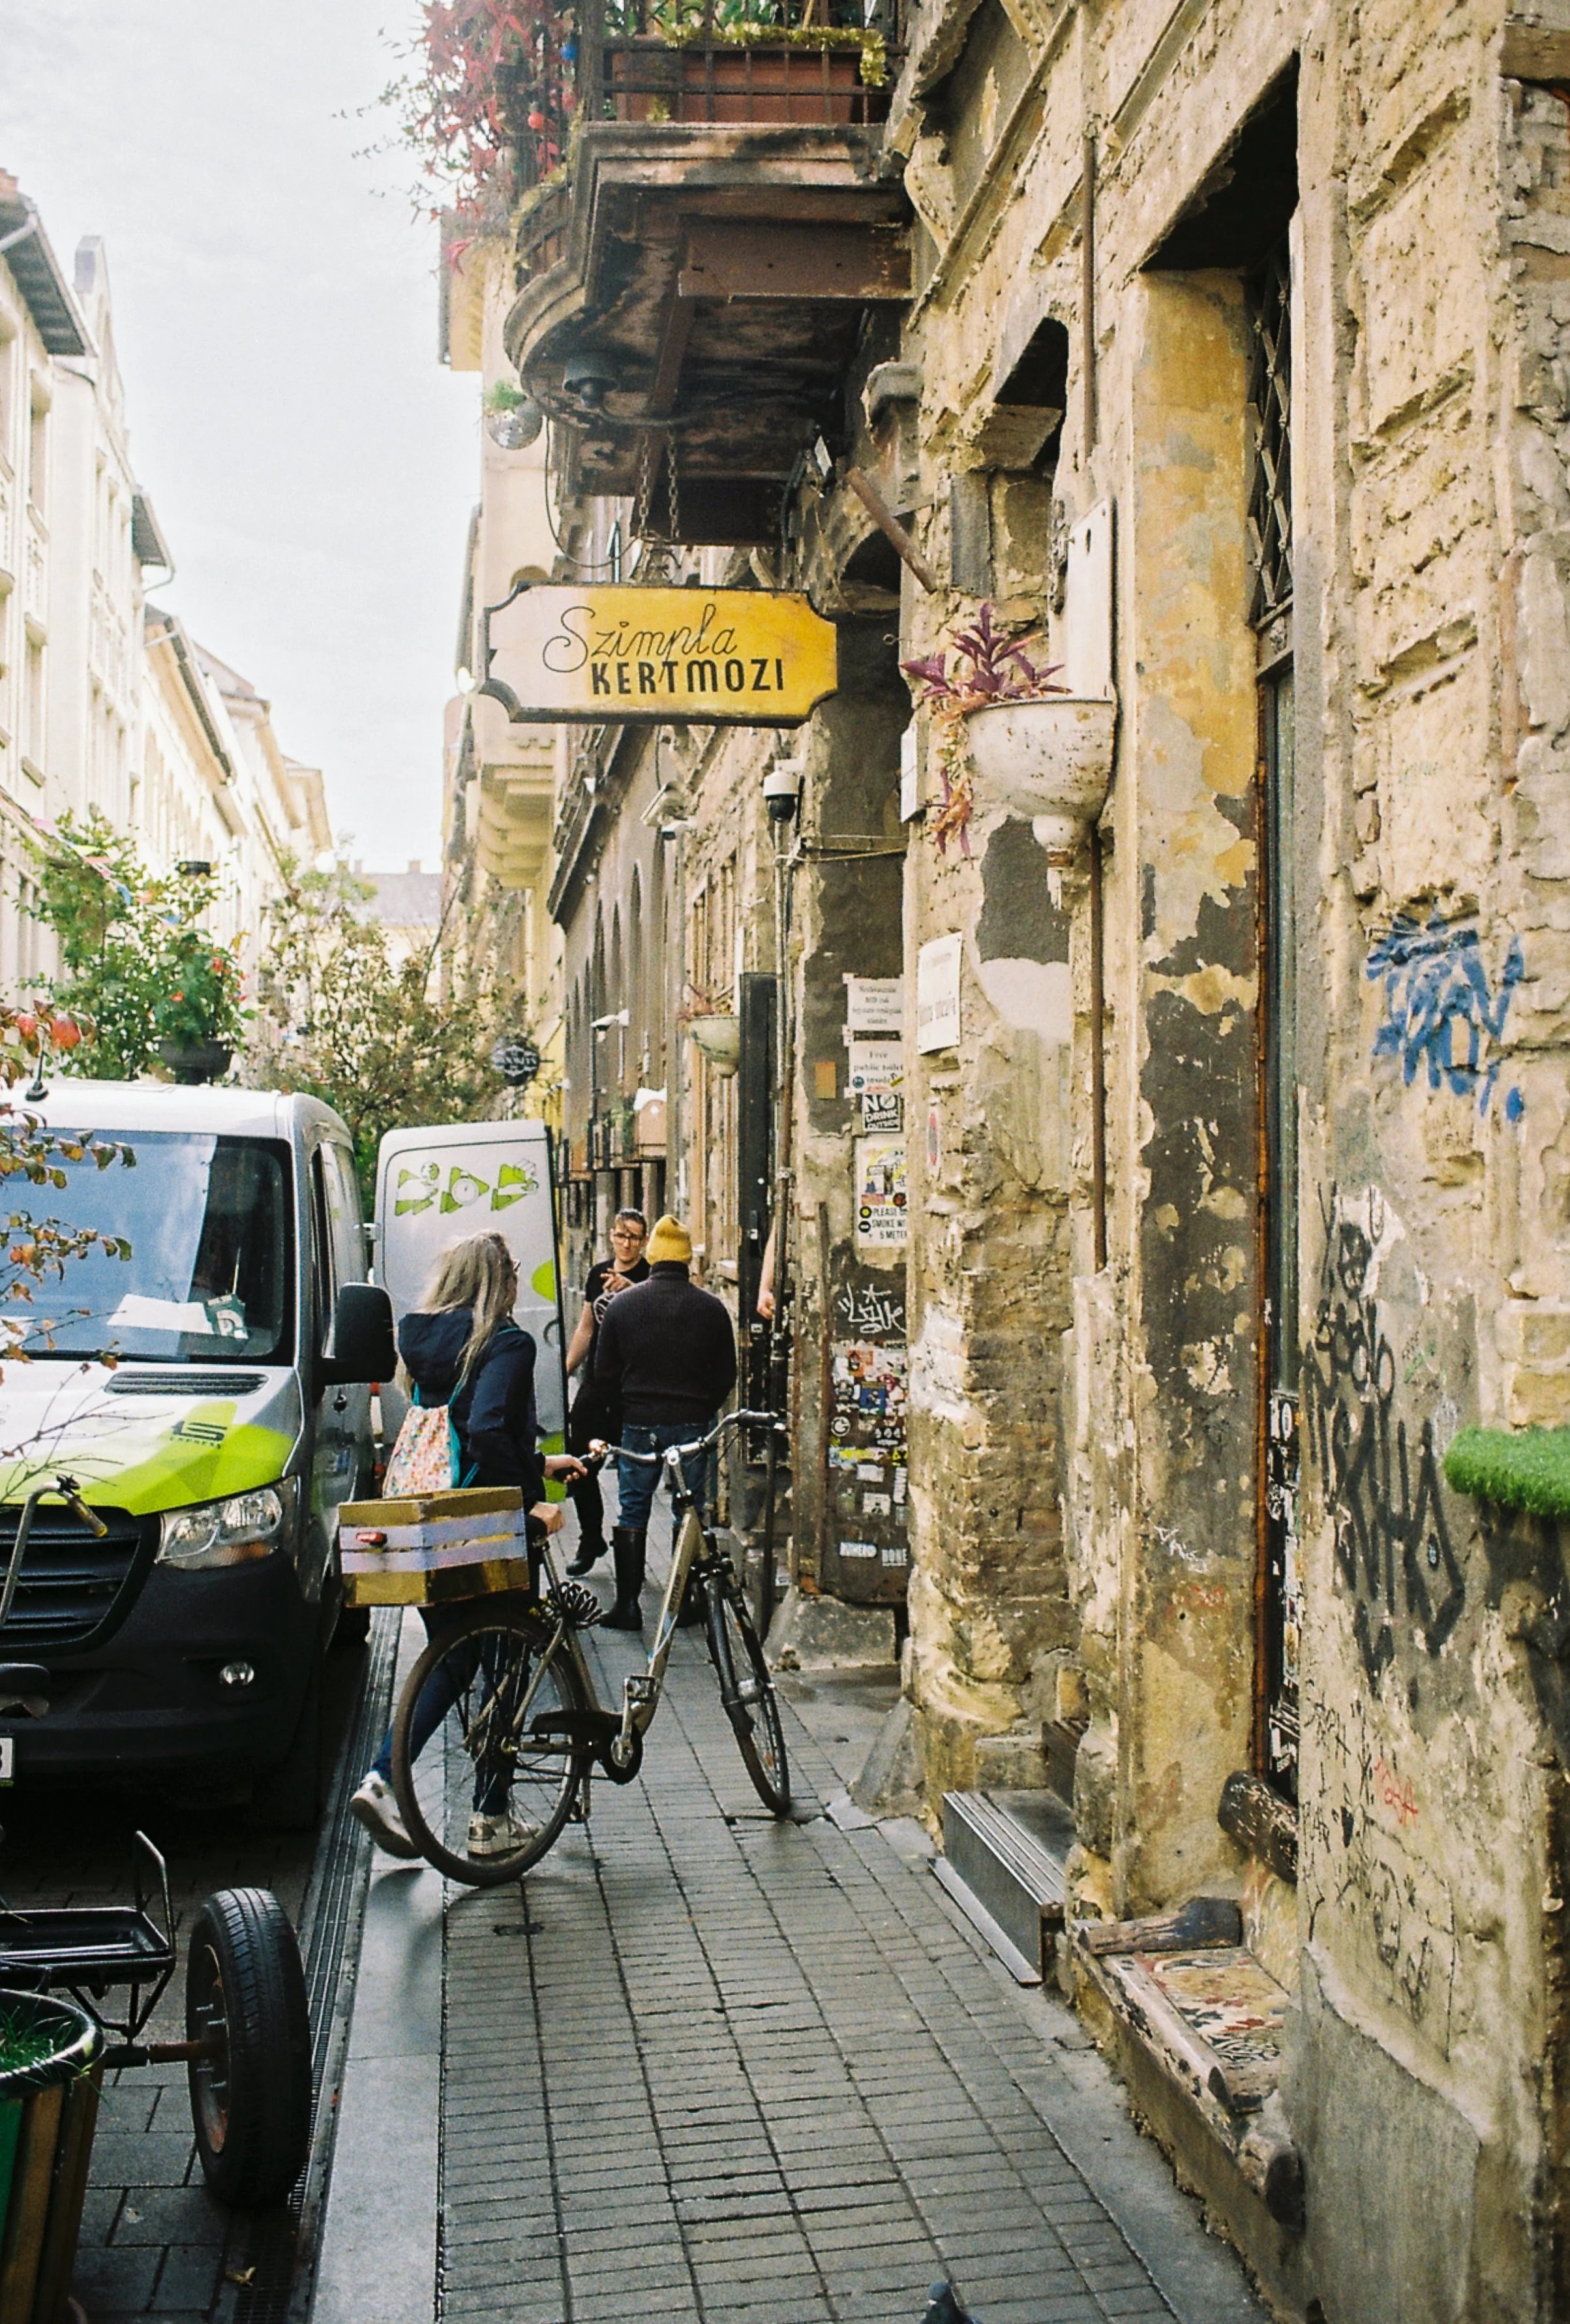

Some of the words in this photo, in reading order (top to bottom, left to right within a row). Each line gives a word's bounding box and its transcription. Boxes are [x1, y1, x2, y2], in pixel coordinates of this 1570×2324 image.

[543, 604, 738, 682] Szimpla
[592, 658, 783, 694] KERTMOZI
[854, 1063, 879, 1072] public
[864, 1094, 896, 1112] NO
[866, 1109, 898, 1123] DRINK
[873, 1208, 897, 1216] PLEASE
